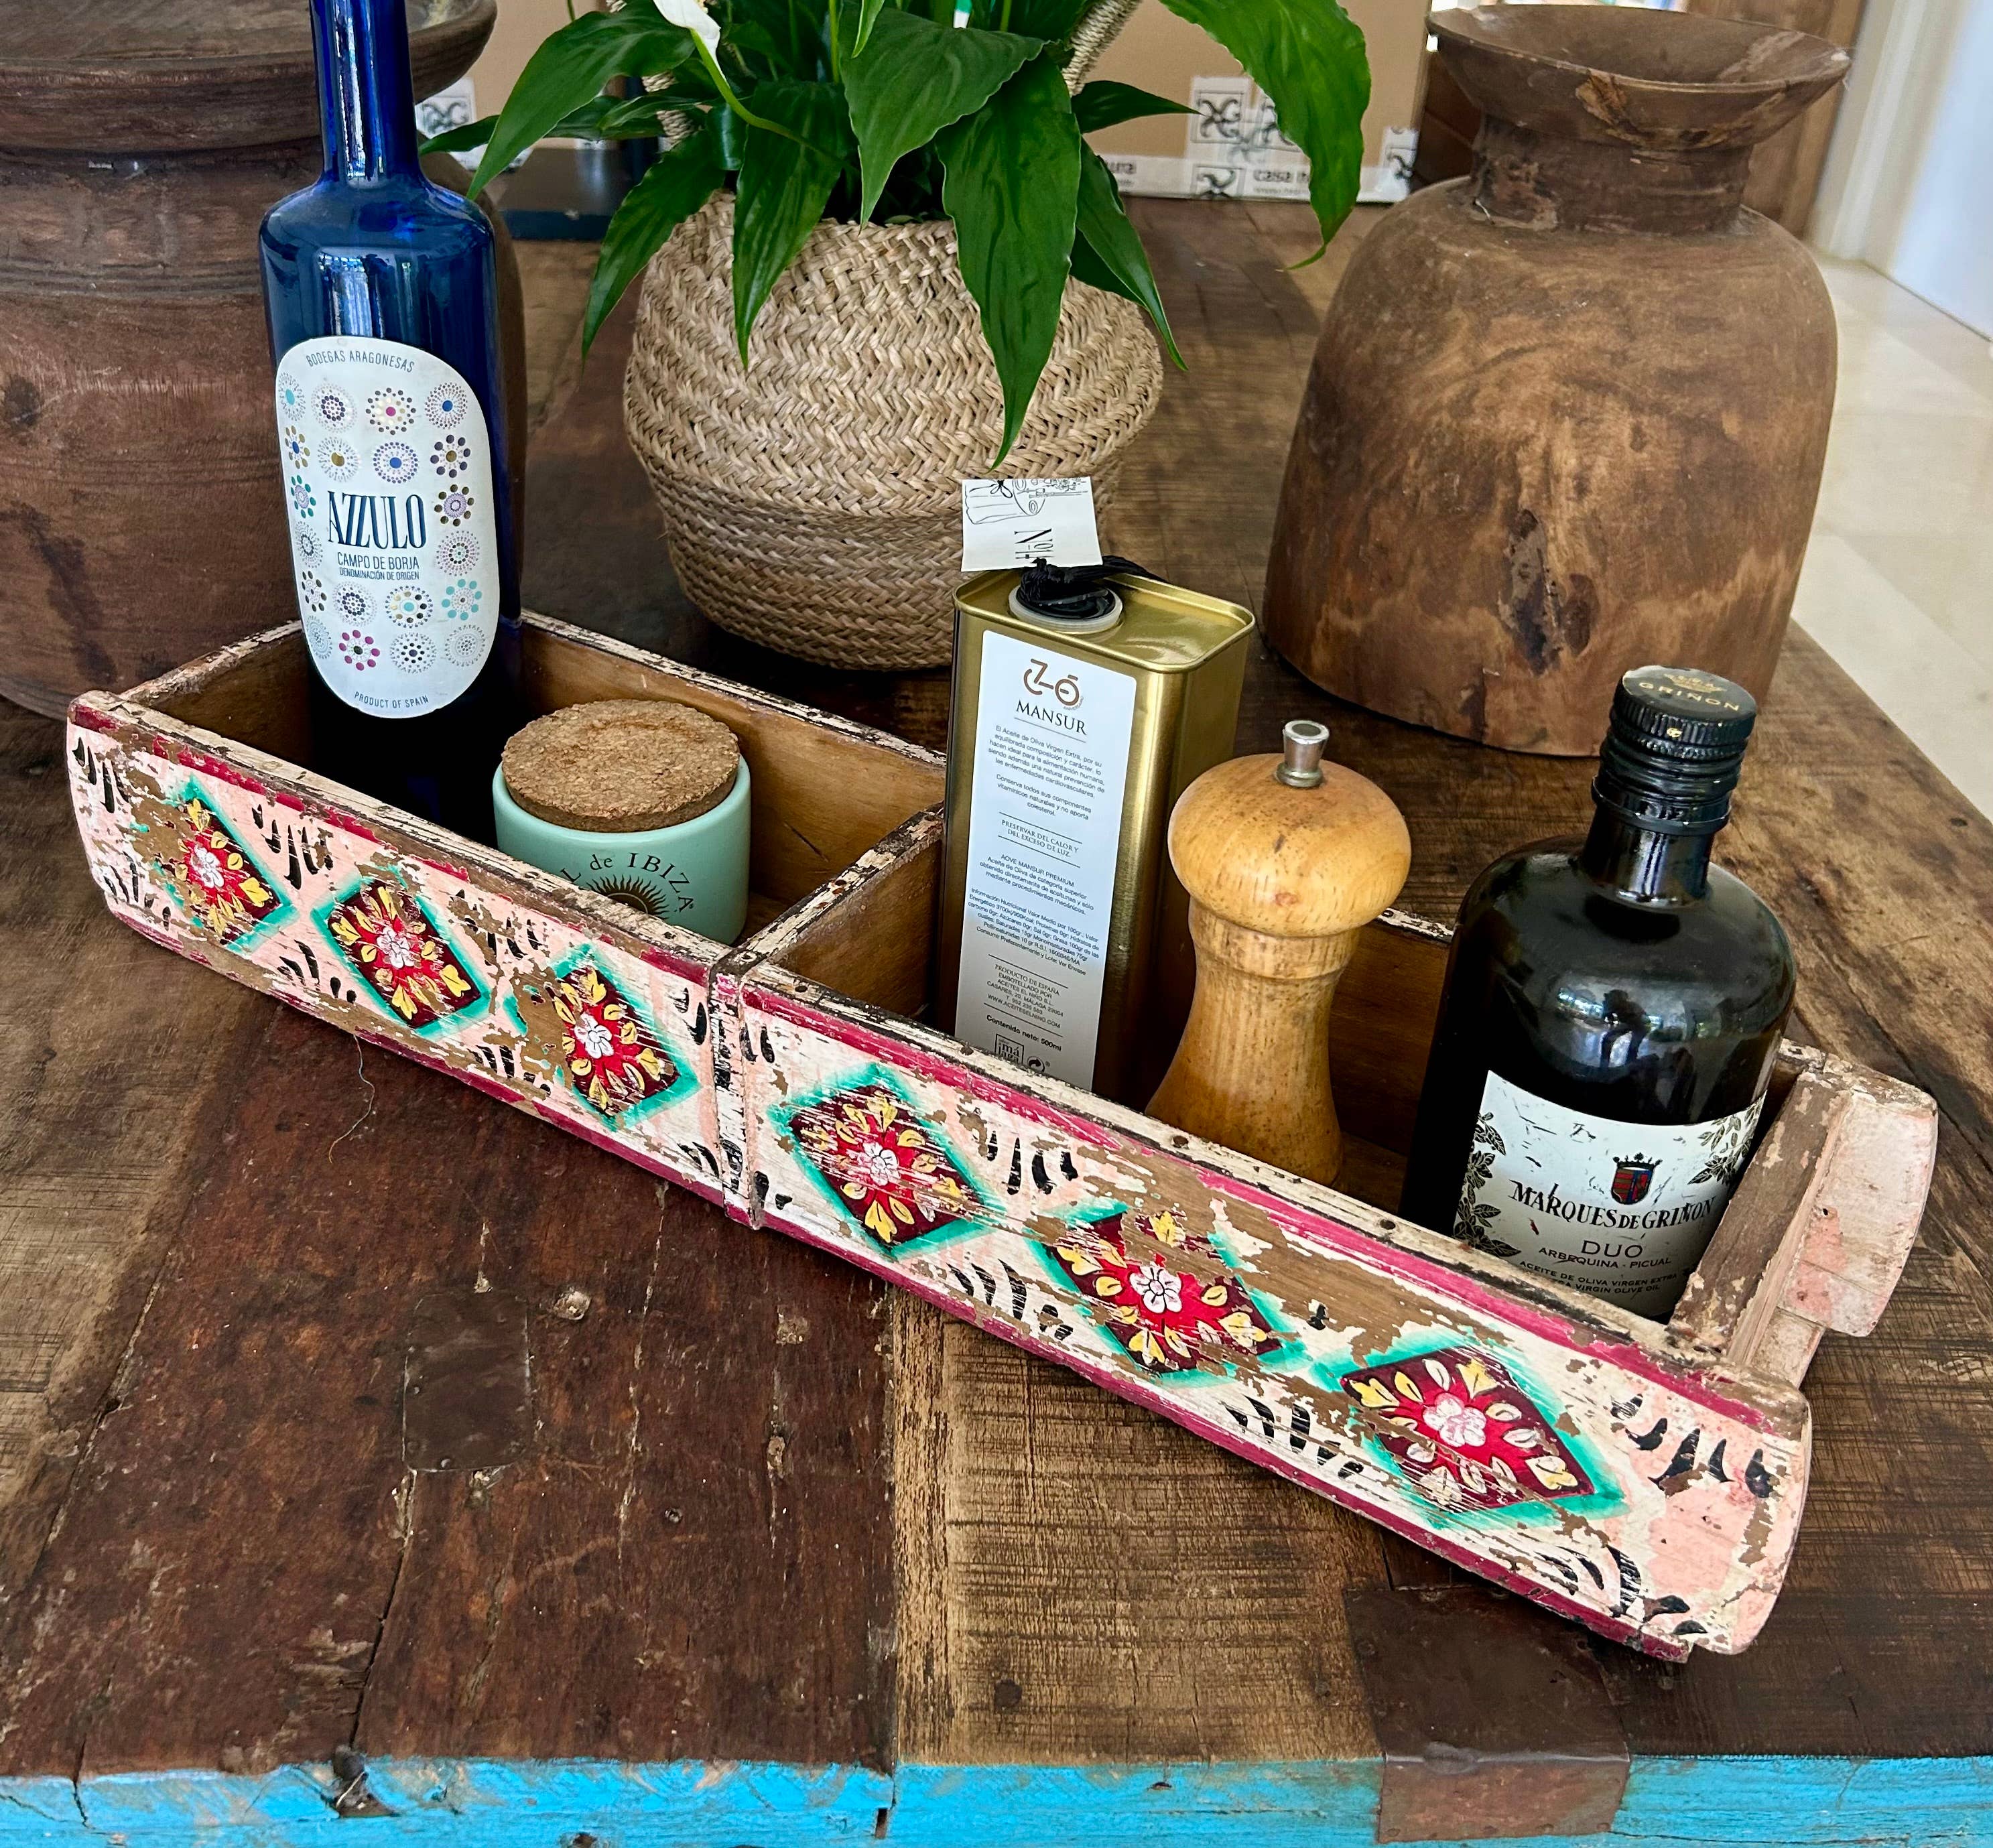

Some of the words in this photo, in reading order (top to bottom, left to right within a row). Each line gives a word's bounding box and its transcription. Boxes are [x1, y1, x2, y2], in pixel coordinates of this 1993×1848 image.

[306, 350, 346, 367] BODEGAS
[349, 350, 415, 373] ARAGONESAS
[327, 490, 426, 549] AZZULO
[337, 551, 370, 569] CAMPO
[373, 556, 385, 570] DE
[389, 556, 420, 570] BORJA
[339, 567, 385, 580] DENOMINACIÓN
[387, 572, 395, 580] DE
[396, 571, 420, 580] ORIGEN
[355, 691, 389, 708] PRODUCT
[393, 700, 402, 709] OF
[405, 695, 429, 708] SPAIN
[1016, 699, 1087, 736] MANSUR
[989, 739, 1006, 750] hacen
[1007, 746, 1021, 754] ideal
[1022, 751, 1035, 761] para
[1042, 758, 1078, 775] alimentación
[994, 733, 1025, 749] equilibrada
[1026, 744, 1062, 763] composición
[1003, 727, 1020, 738] Aceite
[1030, 736, 1044, 747] Oliva
[1045, 742, 1064, 754] Virgen
[1083, 756, 1093, 765] por
[988, 747, 1006, 758] siendo
[1008, 754, 1030, 767] además
[1043, 767, 1062, 778] natural
[1064, 774, 1096, 791] prevención
[995, 757, 1003, 765] las
[1005, 761, 1044, 780] enfermedades
[996, 773, 1022, 788] Conserva
[1023, 783, 1039, 794] todos
[1041, 791, 1051, 799] sus
[1052, 795, 1091, 813] componentes
[1029, 793, 1055, 807] naturales
[1070, 809, 1088, 821] aporta
[1001, 819, 1035, 837] PRESERVAR
[1037, 833, 1049, 842] DEL
[1050, 838, 1073, 851] CALOR
[1007, 828, 1020, 838] DEL
[1021, 834, 1045, 848] EXCESO
[1047, 843, 1055, 852] DE
[590, 854, 613, 870] de
[627, 852, 694, 913] IBIZA
[979, 860, 1003, 874] obtenido
[1005, 870, 1039, 888] directamente
[1049, 888, 1076, 903] aceitunas
[986, 870, 1011, 884] mediante
[1012, 880, 1053, 901] procedimientos
[988, 856, 1005, 867] Aceite
[1014, 866, 1027, 876] Oliva
[1037, 876, 1062, 891] categoría
[1018, 860, 1044, 875] MANSUR
[1045, 871, 1074, 886] PREMIUM
[968, 901, 988, 913] carbono
[994, 964, 1027, 982] PRODUCTO
[1029, 978, 1037, 986] DE
[1038, 981, 1059, 996] ESPAÑA
[997, 978, 1019, 992] ACEITES
[998, 972, 1039, 994] EMBOTELLADO
[1040, 990, 1051, 999] POR
[1023, 994, 1046, 1010] MÁLAGA
[986, 1014, 1020, 1034] Contenido
[1022, 1030, 1039, 1042] neto:
[1041, 1037, 1062, 1052] 500ml
[1508, 1179, 1617, 1229] MARQUES
[1618, 1214, 1640, 1230] DE
[1539, 1247, 1618, 1268] ARBEQUINA
[1630, 1257, 1672, 1268] PICUAL
[1581, 1240, 1643, 1258] DUO
[1519, 1260, 1558, 1277] ACEITE
[1560, 1272, 1575, 1281] DE
[1578, 1276, 1608, 1286] OLIVA
[1612, 1278, 1647, 1286] VIRGEN
[1650, 1273, 1677, 1285] EXTRA
[1576, 1284, 1611, 1294] VIRGIN
[1614, 1286, 1643, 1294] OLIVE
[1645, 1284, 1660, 1292] OIL
